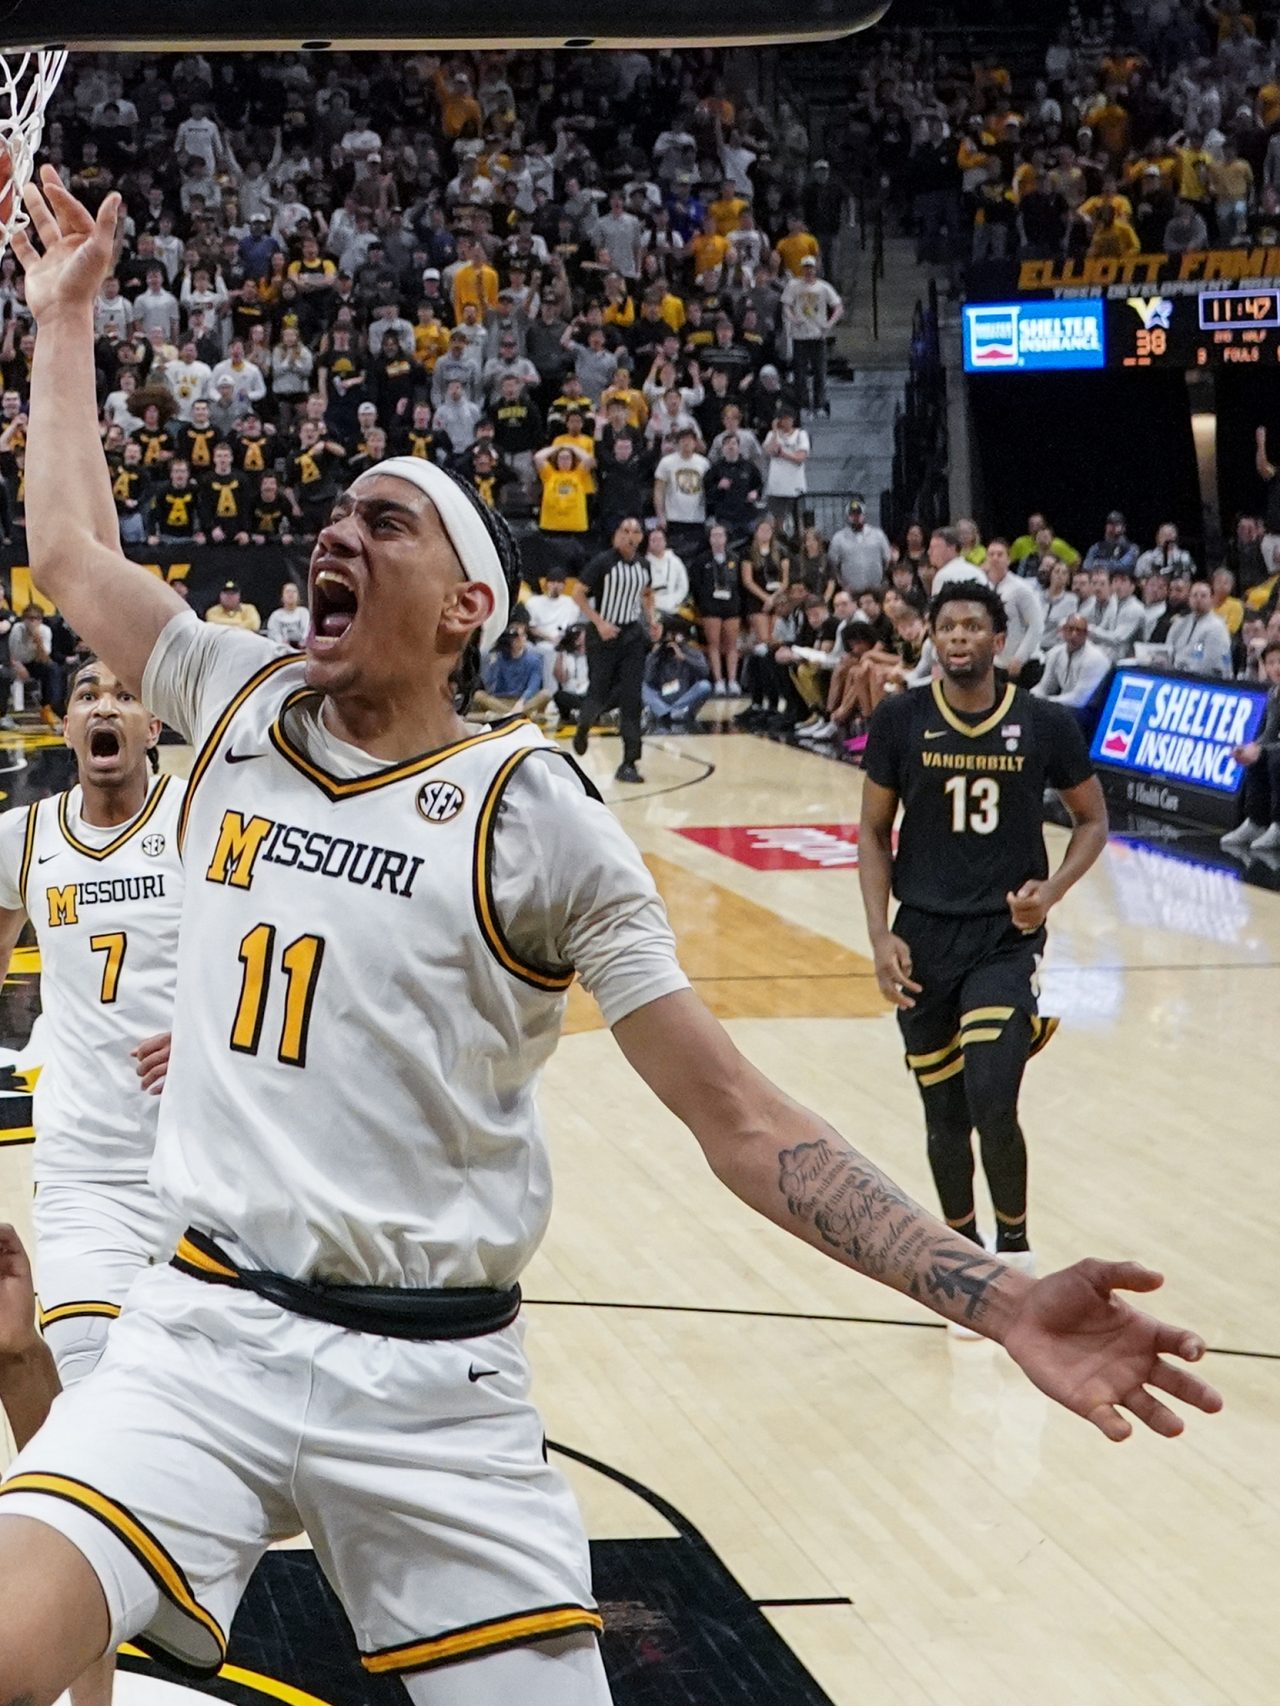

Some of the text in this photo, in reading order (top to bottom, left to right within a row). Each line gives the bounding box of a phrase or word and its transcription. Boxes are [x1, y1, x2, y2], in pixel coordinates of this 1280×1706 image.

[1149, 684, 1253, 745] SHELTER
[922, 751, 1025, 771] VANDERBILT
[421, 784, 460, 821] SEC
[944, 775, 1000, 835] 13
[206, 809, 425, 898] MISSOURI
[46, 874, 166, 927] MISSOURI
[90, 931, 127, 1004] 7
[230, 922, 326, 1069] 11
